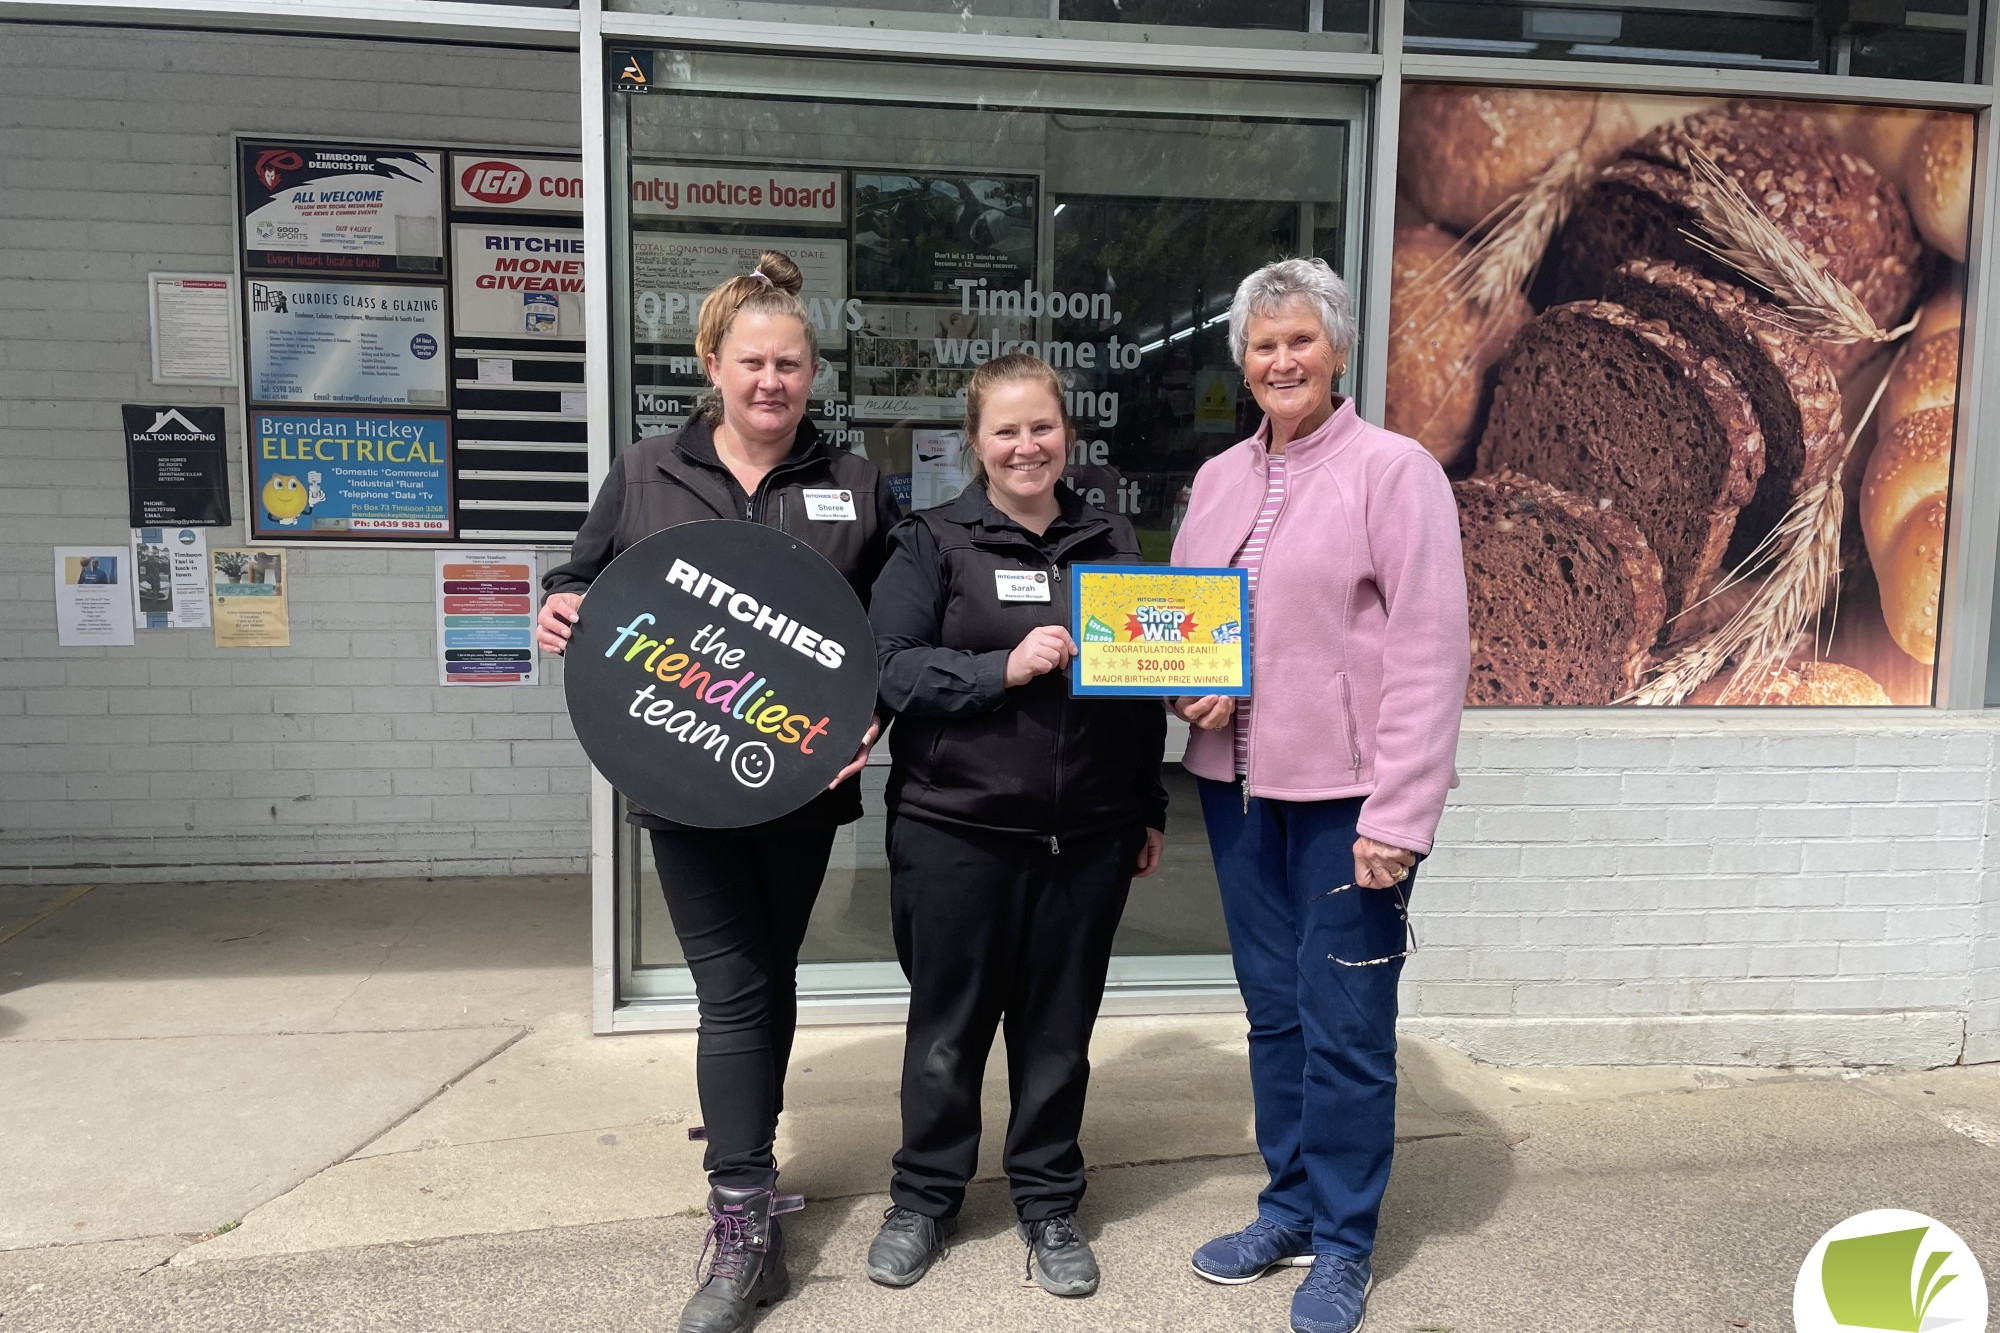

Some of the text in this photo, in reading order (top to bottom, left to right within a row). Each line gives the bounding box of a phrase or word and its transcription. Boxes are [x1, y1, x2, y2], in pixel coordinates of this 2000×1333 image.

[309, 161, 375, 171] DEMONS FNC
[315, 153, 367, 162] TIMBOON
[292, 190, 384, 203] ALL WELCOME
[469, 169, 525, 195] IGA
[687, 180, 762, 205] notice
[769, 179, 836, 208] board
[277, 233, 308, 241] SPORTS
[485, 236, 584, 254] RITCHIE
[634, 244, 667, 252] TOTAL
[669, 244, 728, 254] DONATIONS
[784, 250, 798, 258] TO
[292, 293, 438, 312] CURDIES GLASS & GLAZING
[954, 277, 1122, 324] Timboon,
[1107, 334, 1142, 370] to
[313, 393, 332, 402] Email:
[133, 433, 216, 442] DALTON ROOFING
[262, 418, 424, 442] Brendan Hickey
[262, 438, 444, 464] ELECTRICAL
[1117, 477, 1142, 514] it
[352, 503, 362, 511] Po
[391, 504, 424, 512] Timboon
[373, 520, 399, 528] 0439
[665, 558, 846, 669] RITCHIES
[1136, 605, 1186, 628] Shop
[1141, 624, 1182, 641] Win
[690, 624, 746, 669] the
[1103, 644, 1185, 654] CONGRATULATIONS
[1137, 659, 1185, 672] $20,000
[604, 613, 830, 754] friendliest
[1092, 675, 1229, 684] MAJOR BIRTHDAY PRIZE WINNER
[628, 684, 730, 762] team
